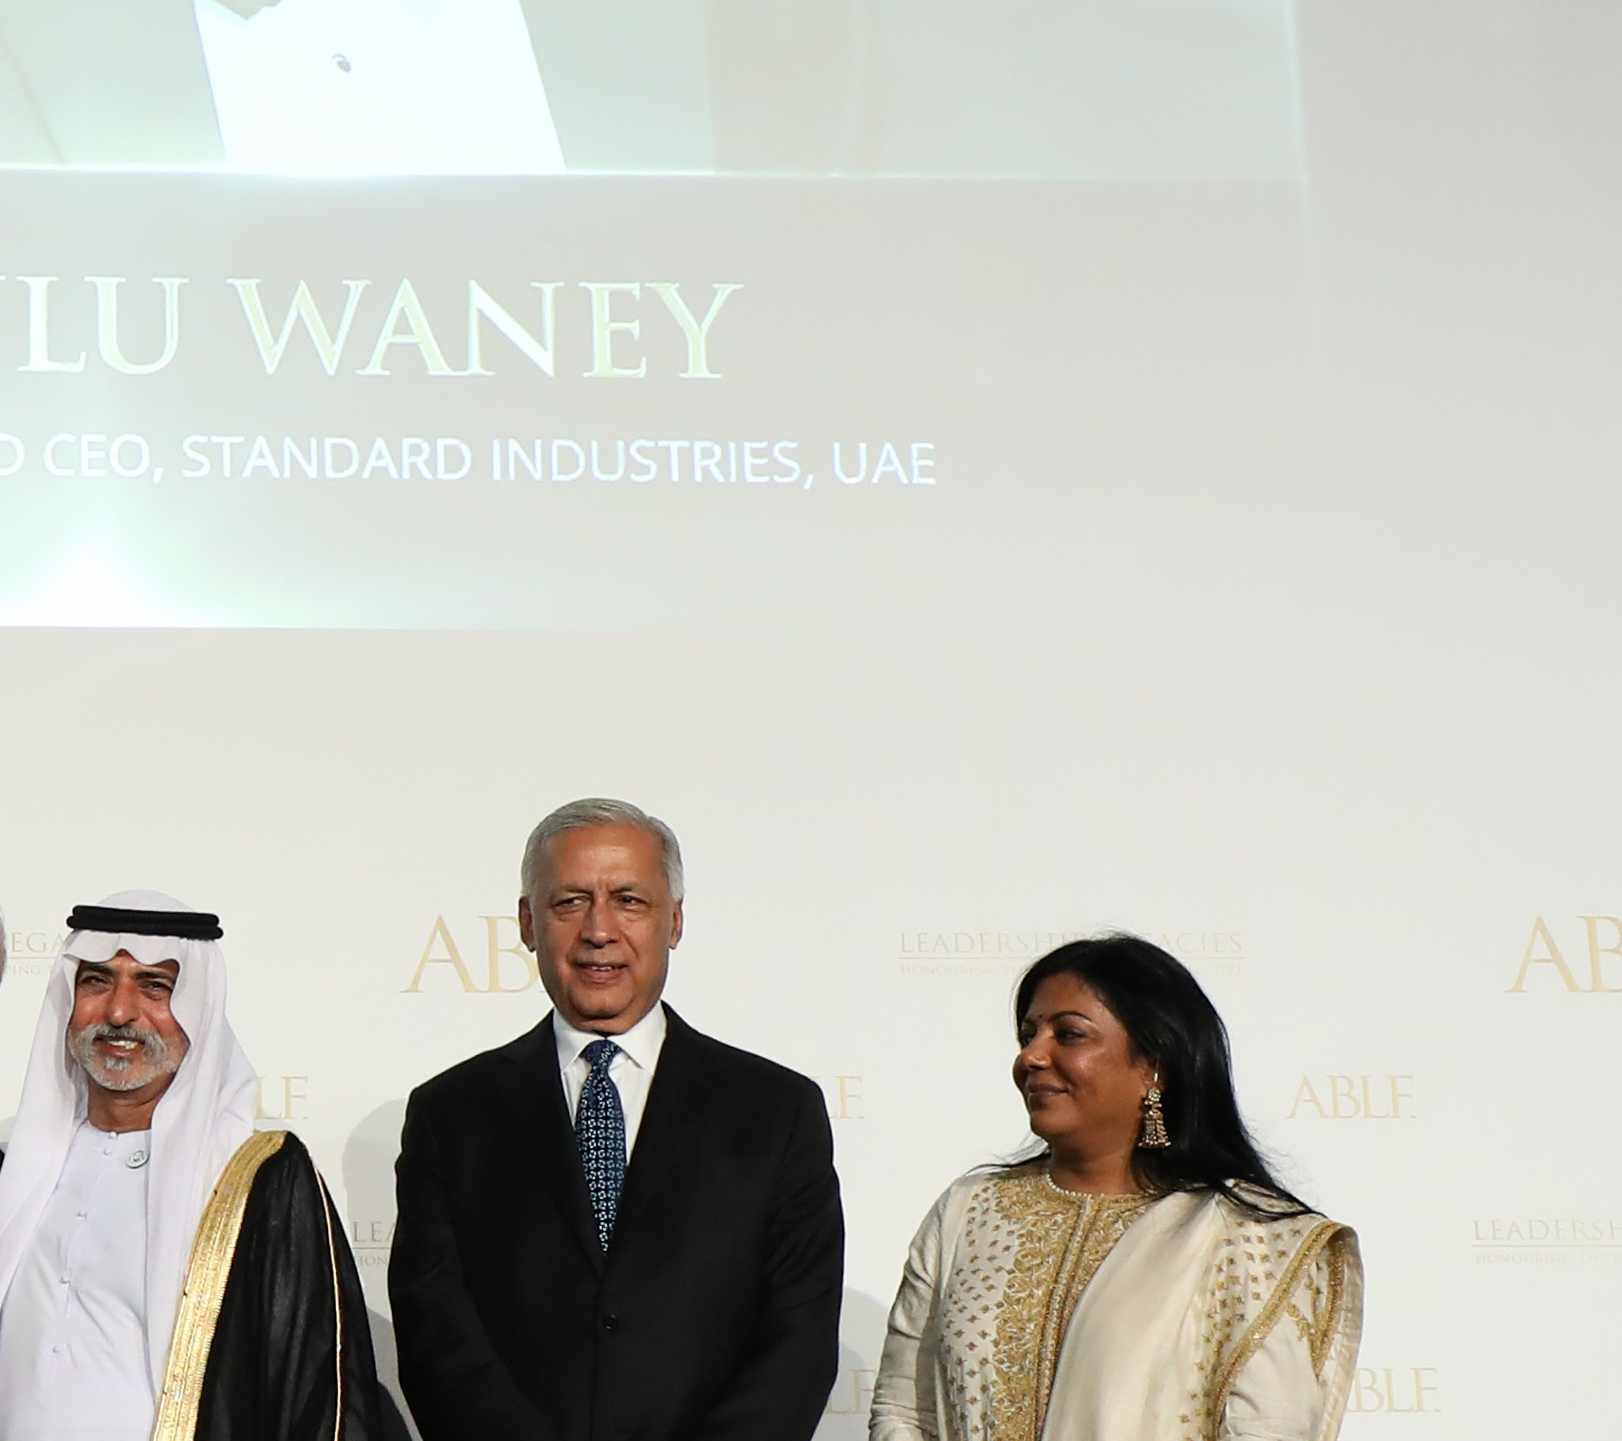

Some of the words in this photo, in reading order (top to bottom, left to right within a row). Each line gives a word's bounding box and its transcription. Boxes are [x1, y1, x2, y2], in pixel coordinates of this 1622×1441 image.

[226, 277, 744, 380] WANEY
[42, 433, 165, 486] CEO,
[181, 435, 472, 480] STANDARD
[490, 437, 815, 490] INDUSTRIES,
[831, 440, 939, 487] UAE
[398, 915, 546, 993] AB
[1287, 1075, 1413, 1119] ABLF
[1346, 1367, 1438, 1412] BLF
